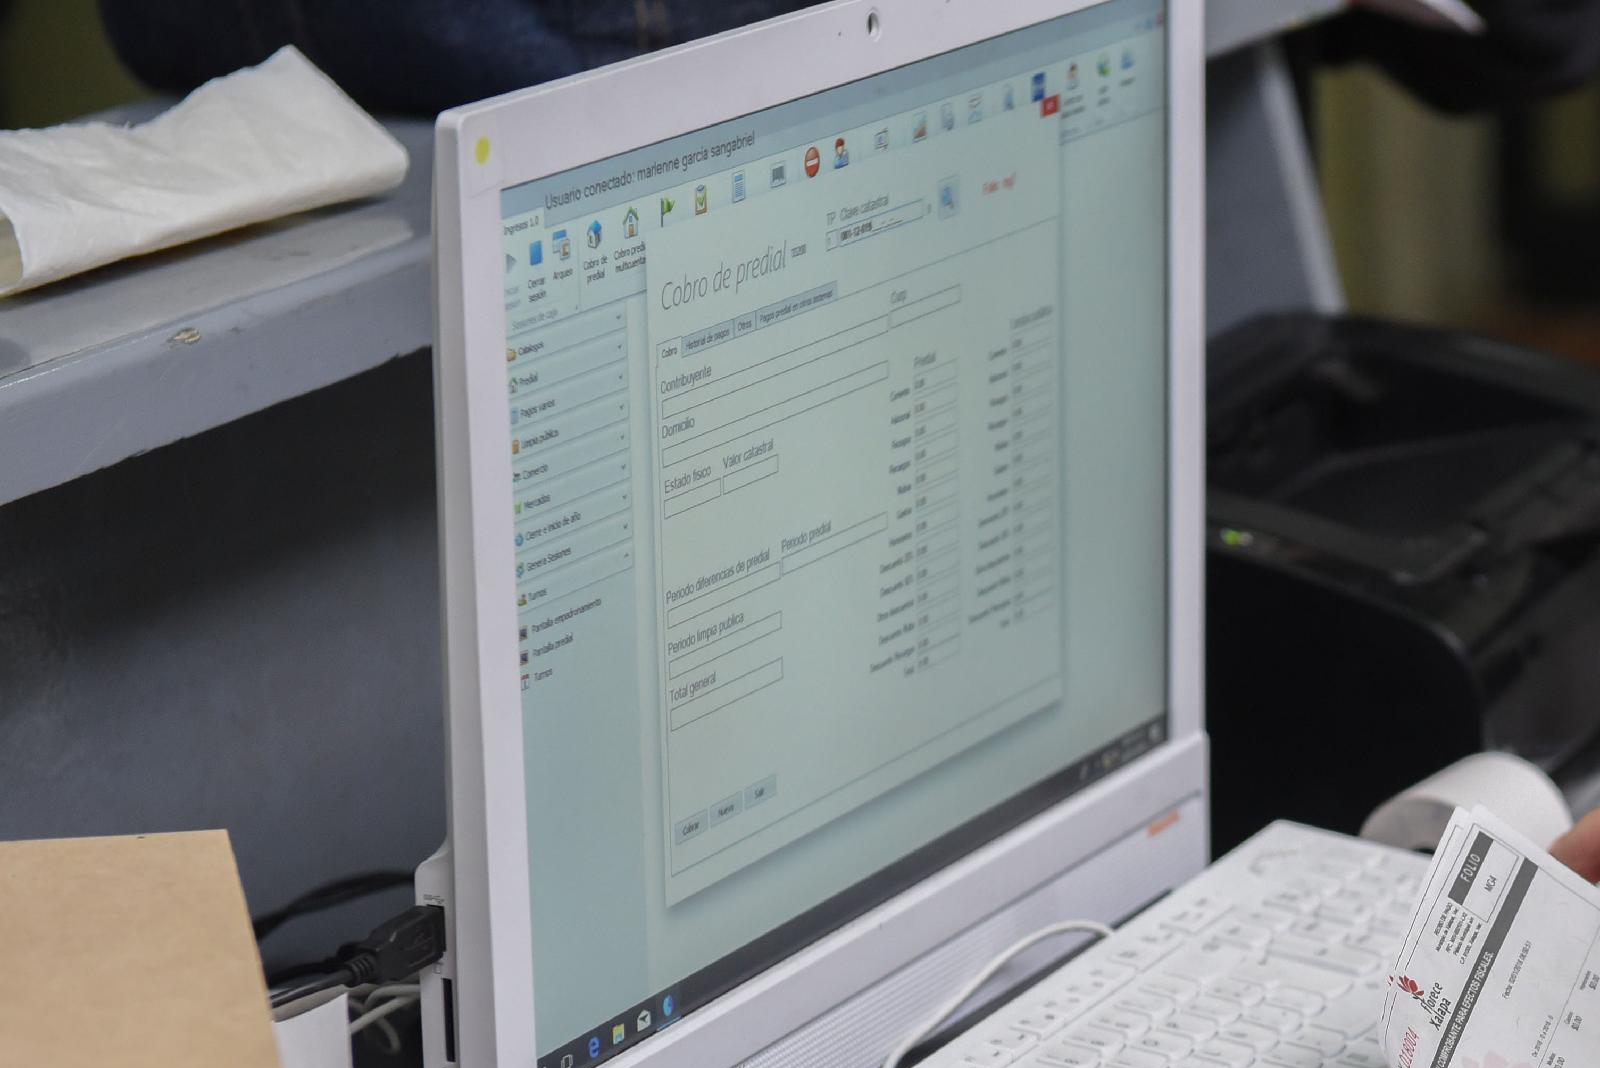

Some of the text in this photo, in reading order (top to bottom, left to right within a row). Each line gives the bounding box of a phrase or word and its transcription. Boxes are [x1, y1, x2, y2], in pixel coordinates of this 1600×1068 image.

[545, 187, 582, 209] Usuario
[583, 172, 635, 197] conectado:
[709, 130, 755, 158] sangabriel
[583, 254, 608, 271] Cobro de
[586, 268, 607, 285] predial
[661, 239, 787, 311] Cobro de predial
[737, 319, 752, 332] Otros
[759, 311, 775, 324] Pagos
[661, 345, 678, 359] Cobro
[706, 332, 714, 344] de
[660, 365, 712, 395] Contribuyente
[661, 416, 695, 439] Domicilio
[722, 438, 774, 469] Valor catastral
[664, 472, 691, 494] Estado
[780, 520, 832, 553] Periodo predial
[665, 548, 770, 604] Periodo diferencias de predial
[667, 633, 696, 655] Periodo
[696, 622, 717, 644] limpia
[669, 671, 717, 704] Total general
[681, 821, 700, 836] Cobrar
[1460, 853, 1481, 882] FOLIO
[1420, 982, 1443, 1014] florece
[1429, 996, 1451, 1031] Xalapa
[1437, 1022, 1461, 1068] COMPROBANTE
[1455, 1007, 1469, 1025] PARA
[1462, 979, 1480, 1009] EFECTOS
[1571, 1015, 1583, 1031] $0.00
[1398, 1027, 1419, 1068] 018004
